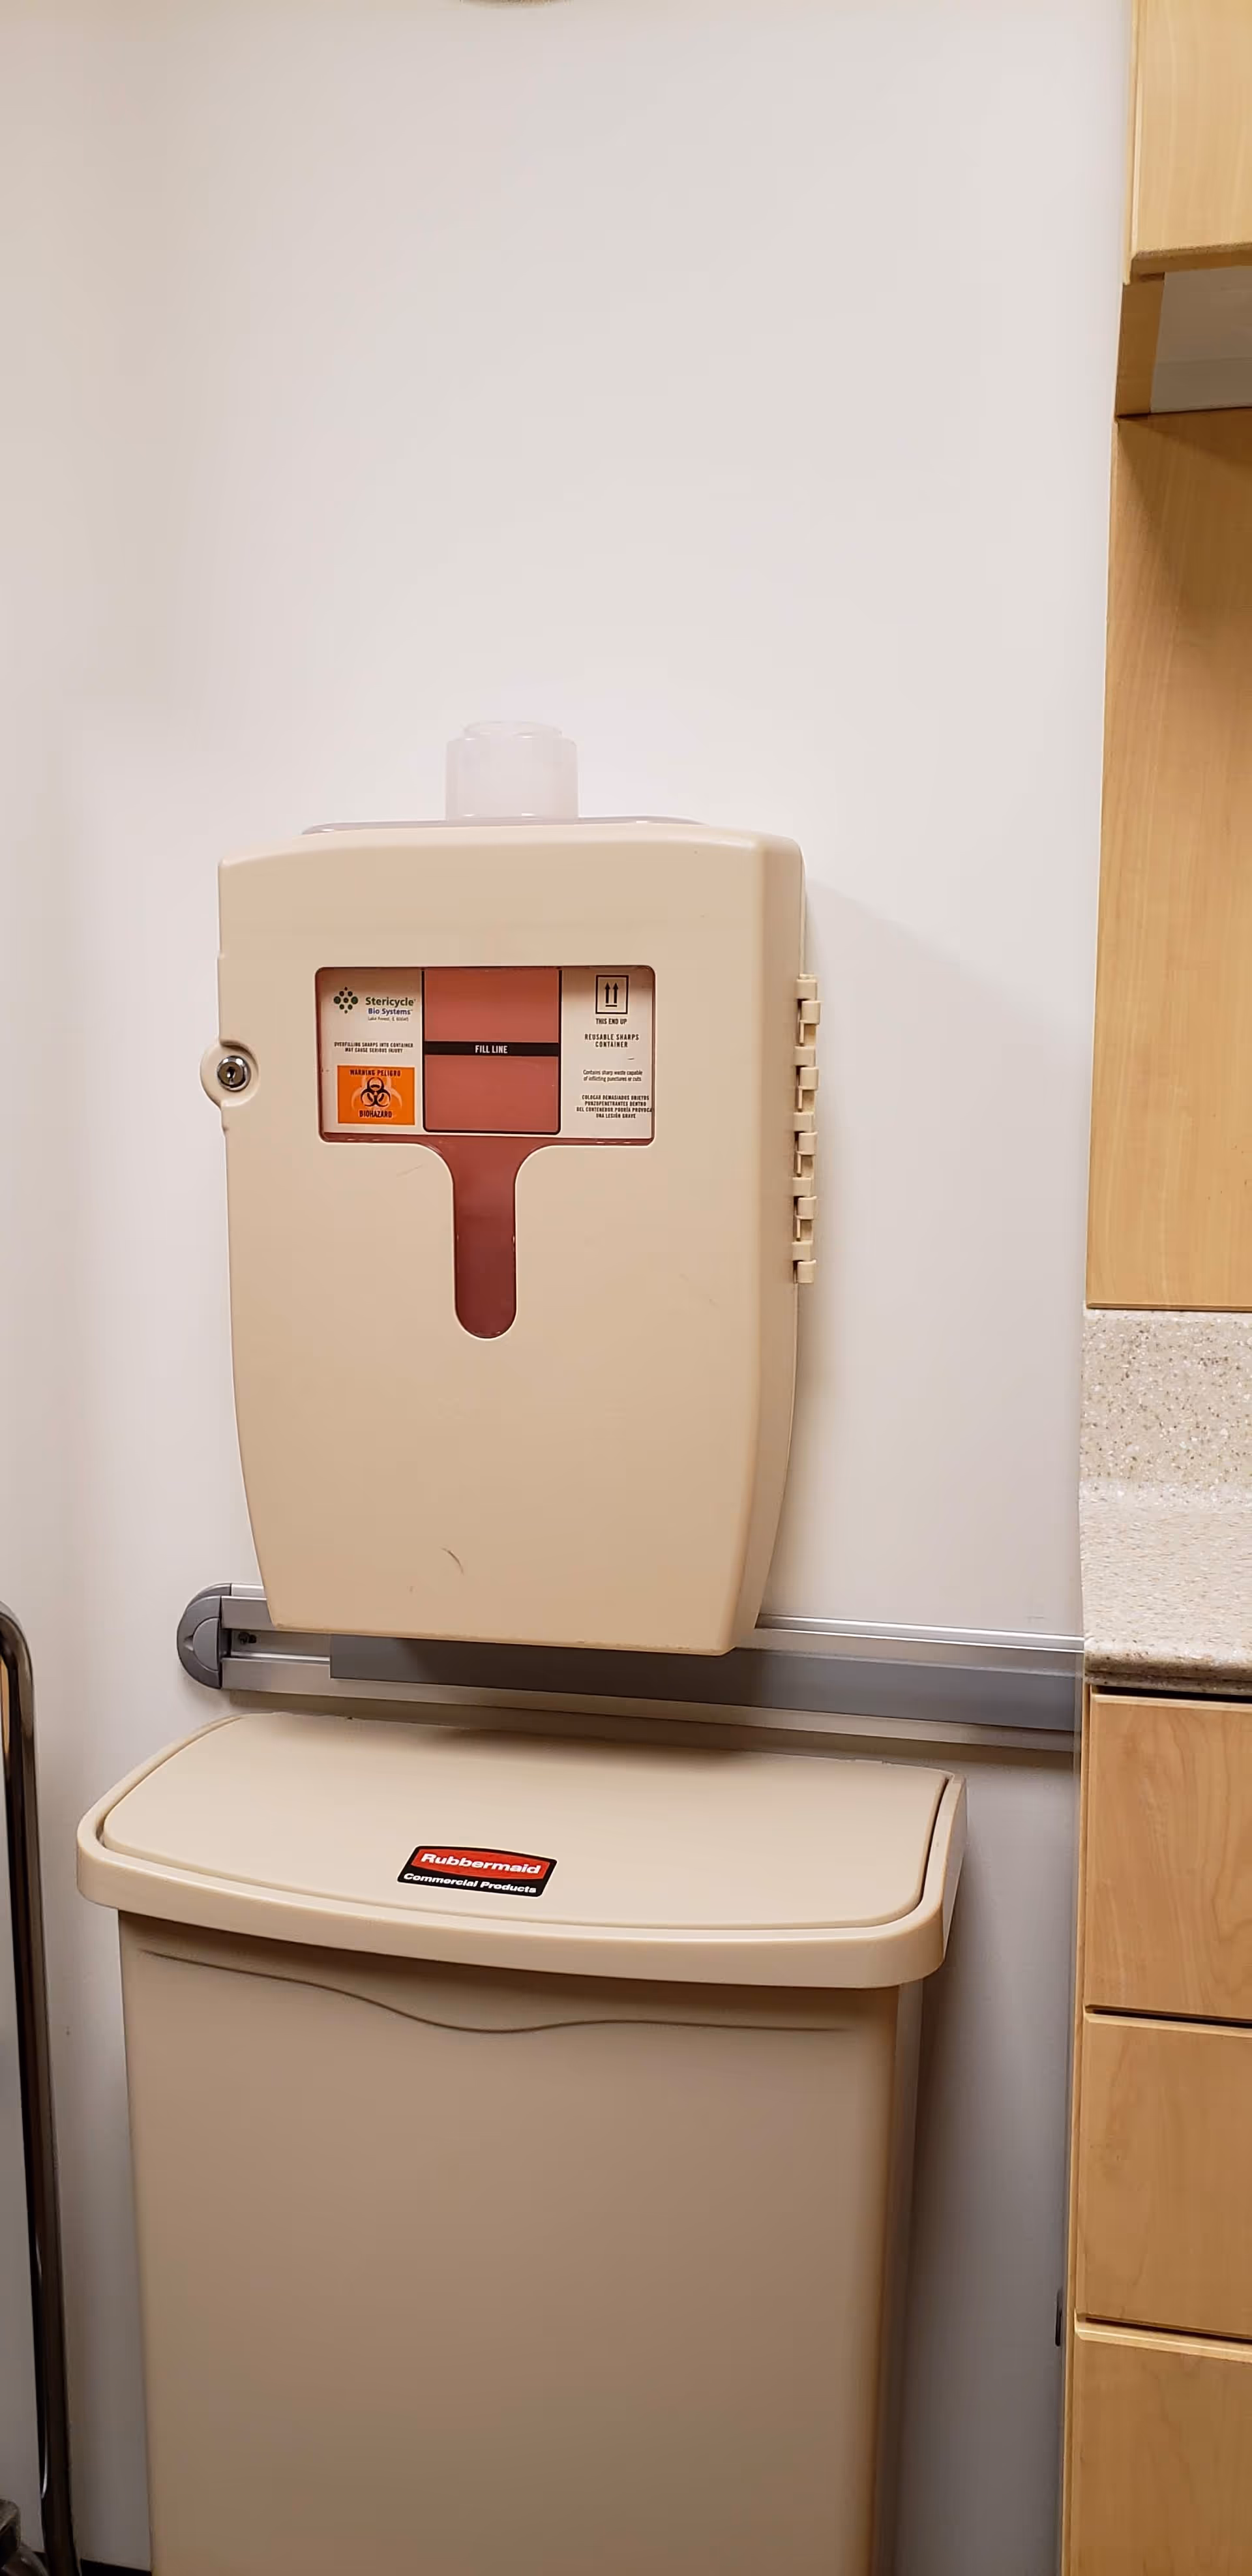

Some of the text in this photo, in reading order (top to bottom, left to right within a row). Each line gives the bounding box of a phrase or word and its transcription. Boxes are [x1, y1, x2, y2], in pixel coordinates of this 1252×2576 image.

[366, 996, 414, 1008] Stericycle
[382, 1008, 411, 1016] Systems
[475, 1045, 508, 1054] FILL LINE
[421, 1853, 541, 1874] Rubbermaid
[403, 1873, 537, 1893] Commercial Products
